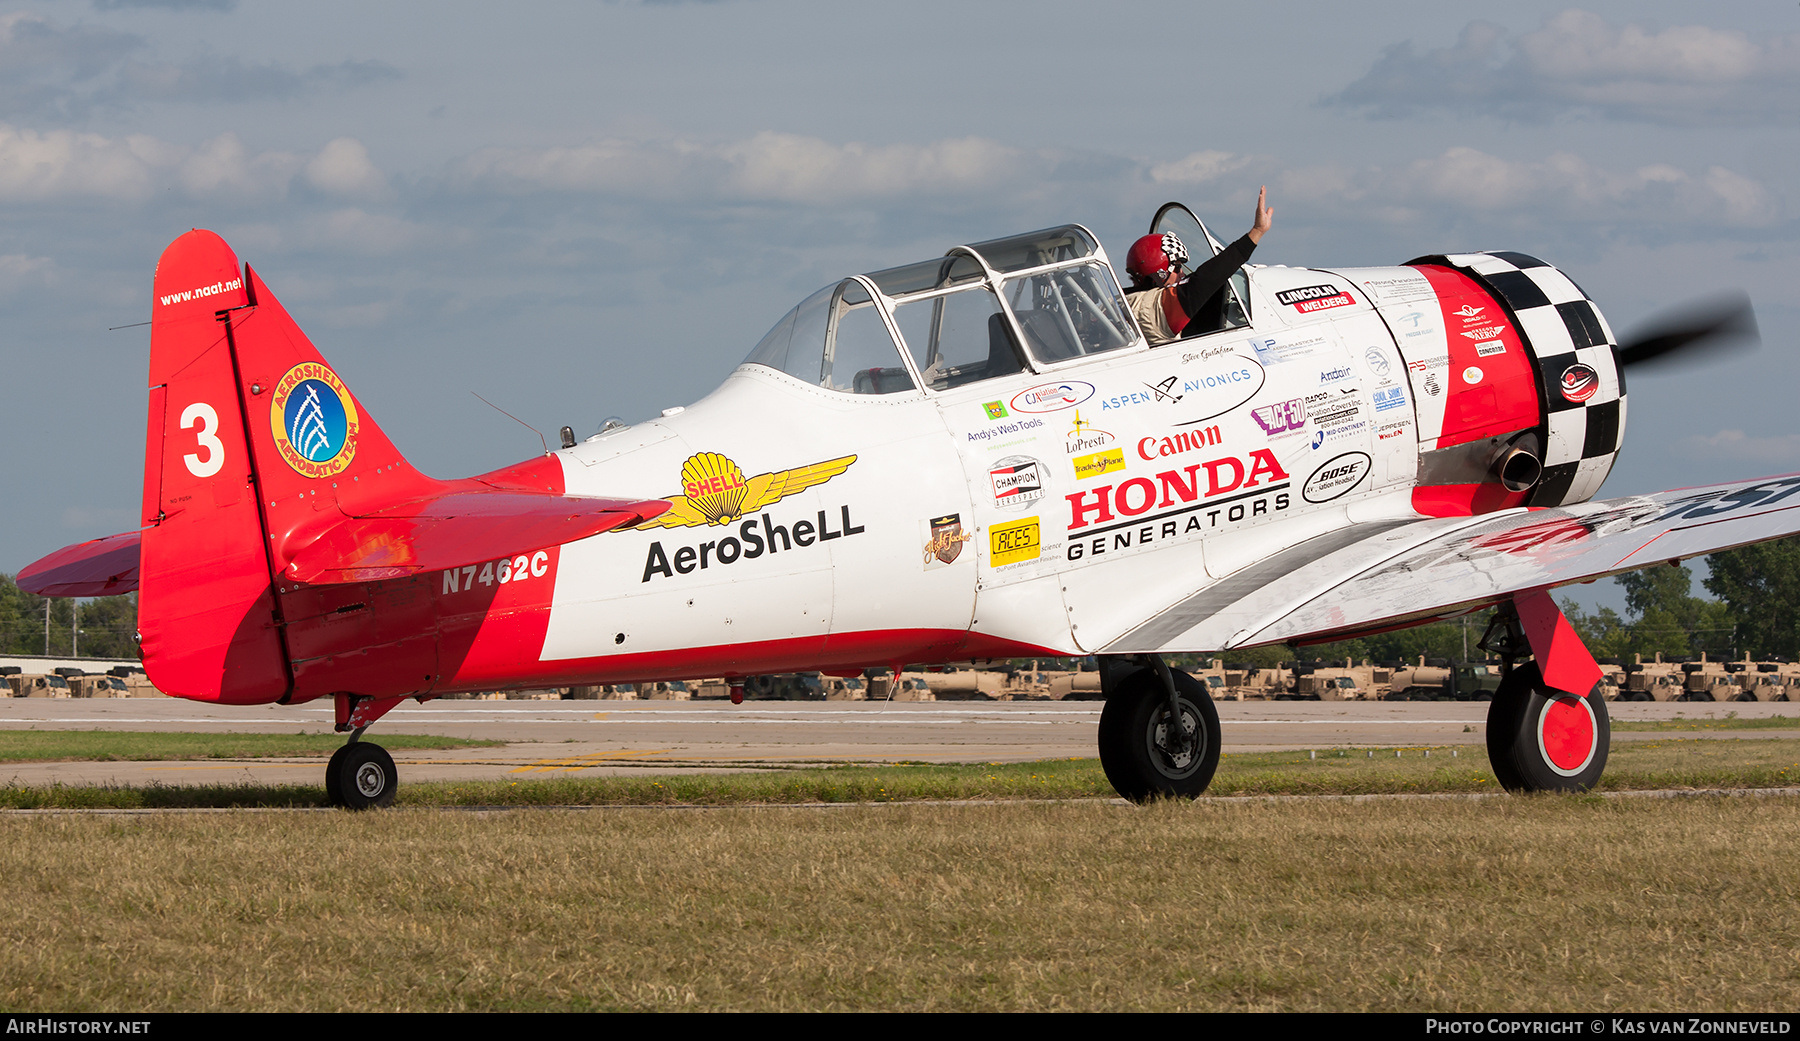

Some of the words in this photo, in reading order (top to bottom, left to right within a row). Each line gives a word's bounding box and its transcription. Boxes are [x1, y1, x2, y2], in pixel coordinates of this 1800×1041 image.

[161, 277, 241, 306] www.naat.net
[1280, 286, 1337, 303] LINCOLN
[1301, 296, 1350, 312] WELDERS
[1475, 330, 1497, 340] AERO
[1253, 339, 1276, 352] LP
[1320, 365, 1351, 383] Andair
[275, 364, 344, 410] AEROSHELL
[1102, 391, 1150, 411] ASPEN
[1305, 392, 1328, 404] RAPCO
[1306, 407, 1331, 419] Aviation
[1331, 401, 1352, 412] Covers
[1351, 399, 1363, 407] Inc.
[967, 429, 998, 442] Andy's
[997, 423, 1019, 435] Web
[1018, 418, 1043, 431] Tools
[1327, 428, 1367, 441] INSTRUMENTS
[1378, 420, 1411, 432] JEPPESEN
[180, 402, 225, 478] 3
[277, 438, 342, 477] AEROBATIC
[340, 421, 358, 462] TEAM
[1065, 433, 1105, 454] LoPresti
[1137, 425, 1222, 460] Canon
[995, 472, 1036, 489] CHAMPION
[1319, 462, 1360, 482] BOSE
[1334, 475, 1355, 487] Headset
[686, 473, 744, 500] SHELL
[1065, 448, 1289, 530] HONDA
[996, 490, 1044, 507] AEROSPACE
[1067, 493, 1290, 561] GENERATORS
[998, 527, 1031, 551] ACES
[441, 551, 549, 595] N7462C
[1017, 559, 1039, 569] Aviation
